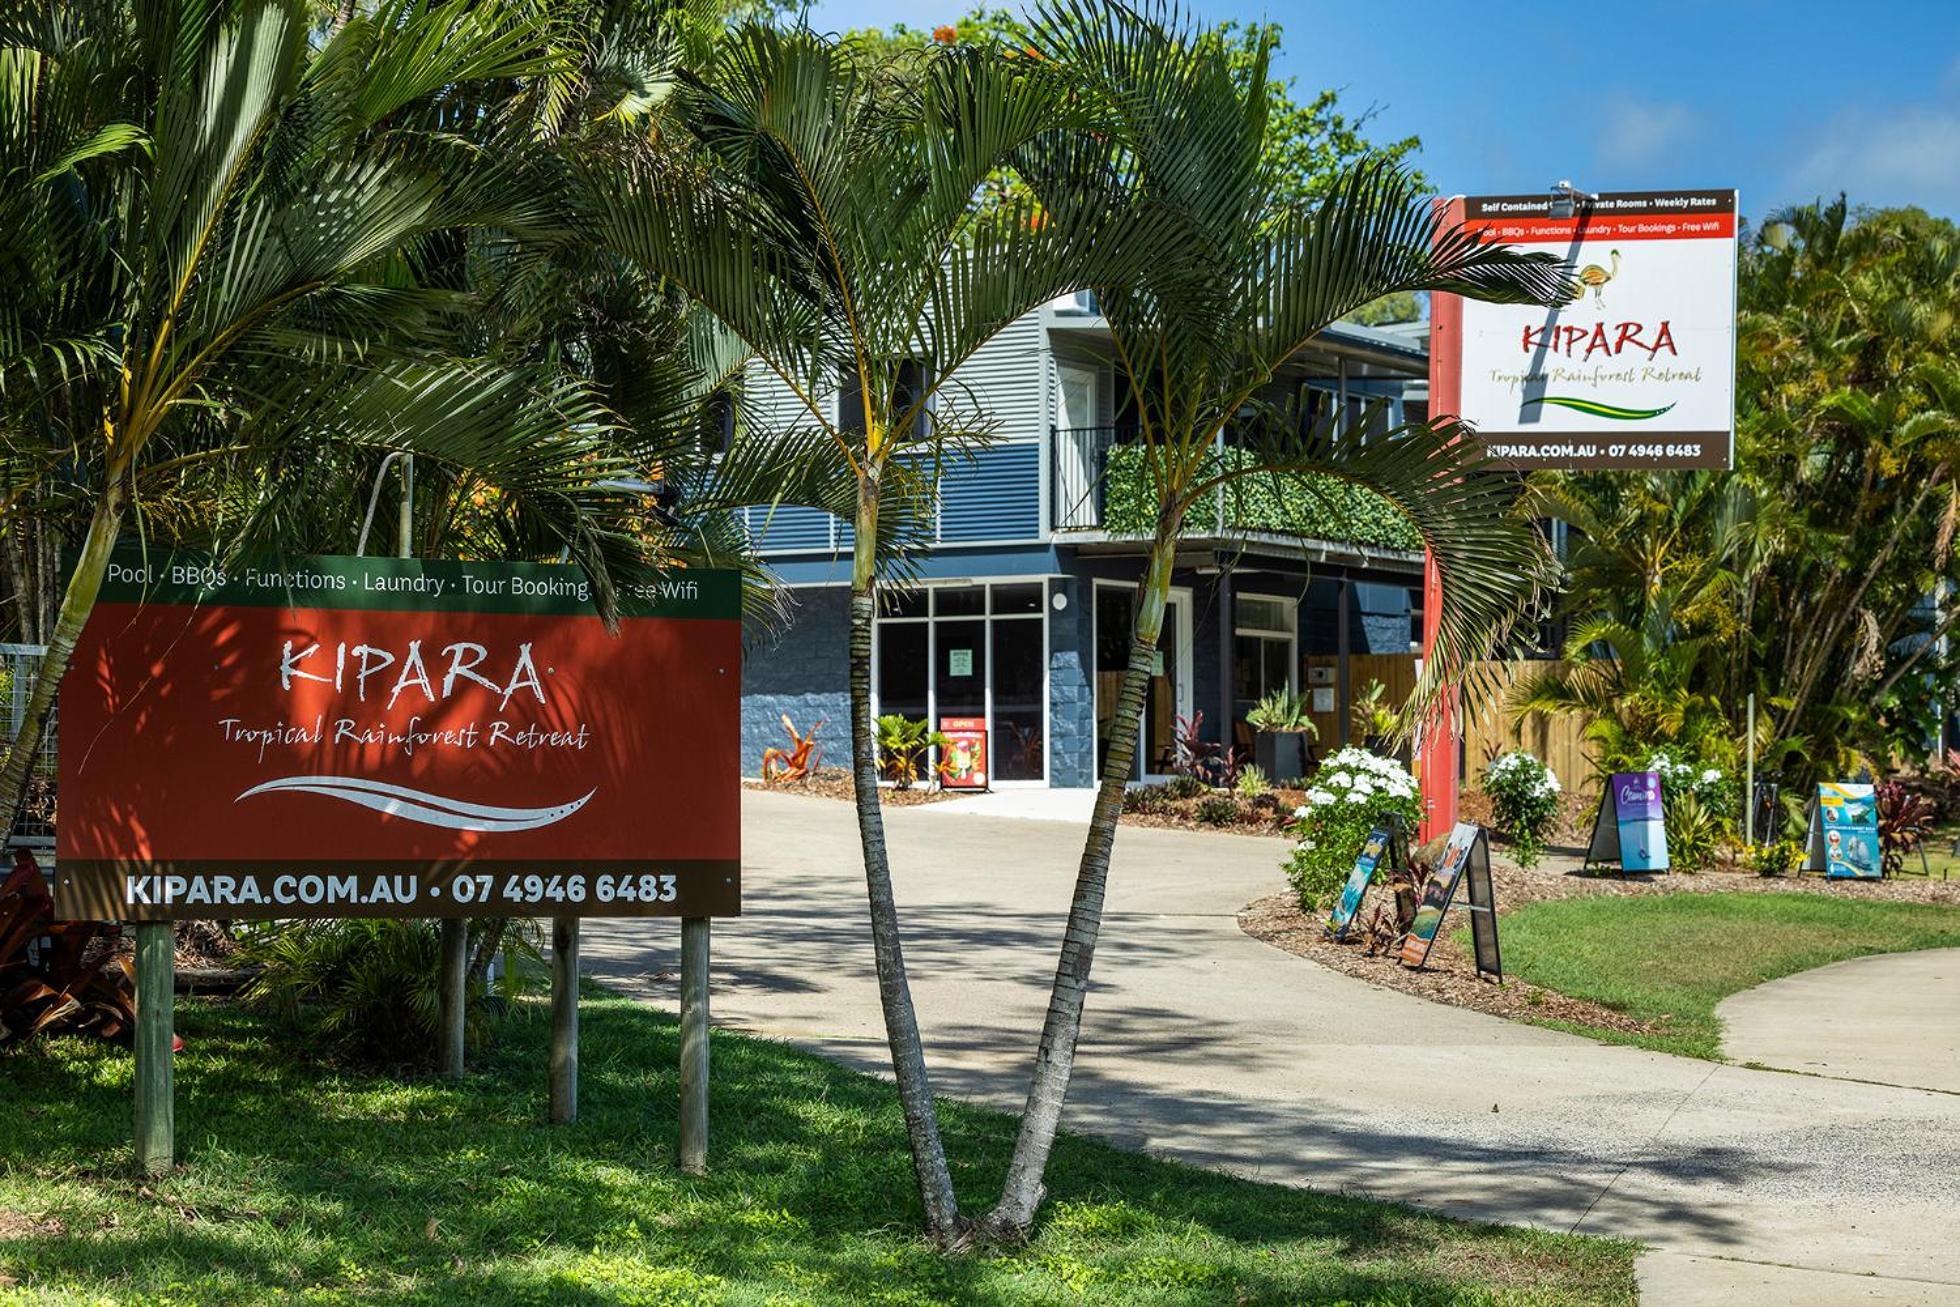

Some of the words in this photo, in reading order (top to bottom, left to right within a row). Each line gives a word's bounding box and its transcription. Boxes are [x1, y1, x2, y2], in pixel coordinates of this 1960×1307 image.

[1481, 201, 1500, 212] Self
[1501, 200, 1548, 212] Contained
[1616, 199, 1647, 209] Rooms
[1654, 197, 1689, 209] Weekly
[1690, 197, 1717, 207] Rates
[1502, 226, 1525, 238] BBQs
[1530, 226, 1572, 236] Functions
[1617, 223, 1637, 233] Tour
[1638, 222, 1677, 234] Bookings
[1682, 221, 1701, 232] Free
[1702, 220, 1721, 232] Wifi
[1521, 319, 1679, 363] KIPARA
[1490, 366, 1547, 394] Tropical
[1552, 364, 1636, 388] Rainforest
[1642, 366, 1704, 384] Retreat
[1486, 444, 1597, 458] KIPARA.COM.AU
[1608, 444, 1626, 457] 07
[1627, 444, 1663, 457] 4946
[1666, 444, 1702, 457] 6483
[107, 563, 154, 584] Pool
[171, 565, 227, 591] BBQs
[246, 568, 346, 590] Functions
[364, 571, 445, 598] Laundry
[462, 575, 506, 595] Tour
[511, 576, 593, 602] Booking
[662, 581, 699, 601] Wifi
[280, 639, 547, 712] KIPARA
[218, 714, 324, 764] Tropical
[334, 716, 480, 756] Rainforest
[489, 719, 591, 752] Retreat
[126, 874, 418, 905] KIPARA.COM.AU
[451, 874, 494, 903] 07
[502, 874, 586, 903] 4946
[595, 873, 678, 902] 6483
